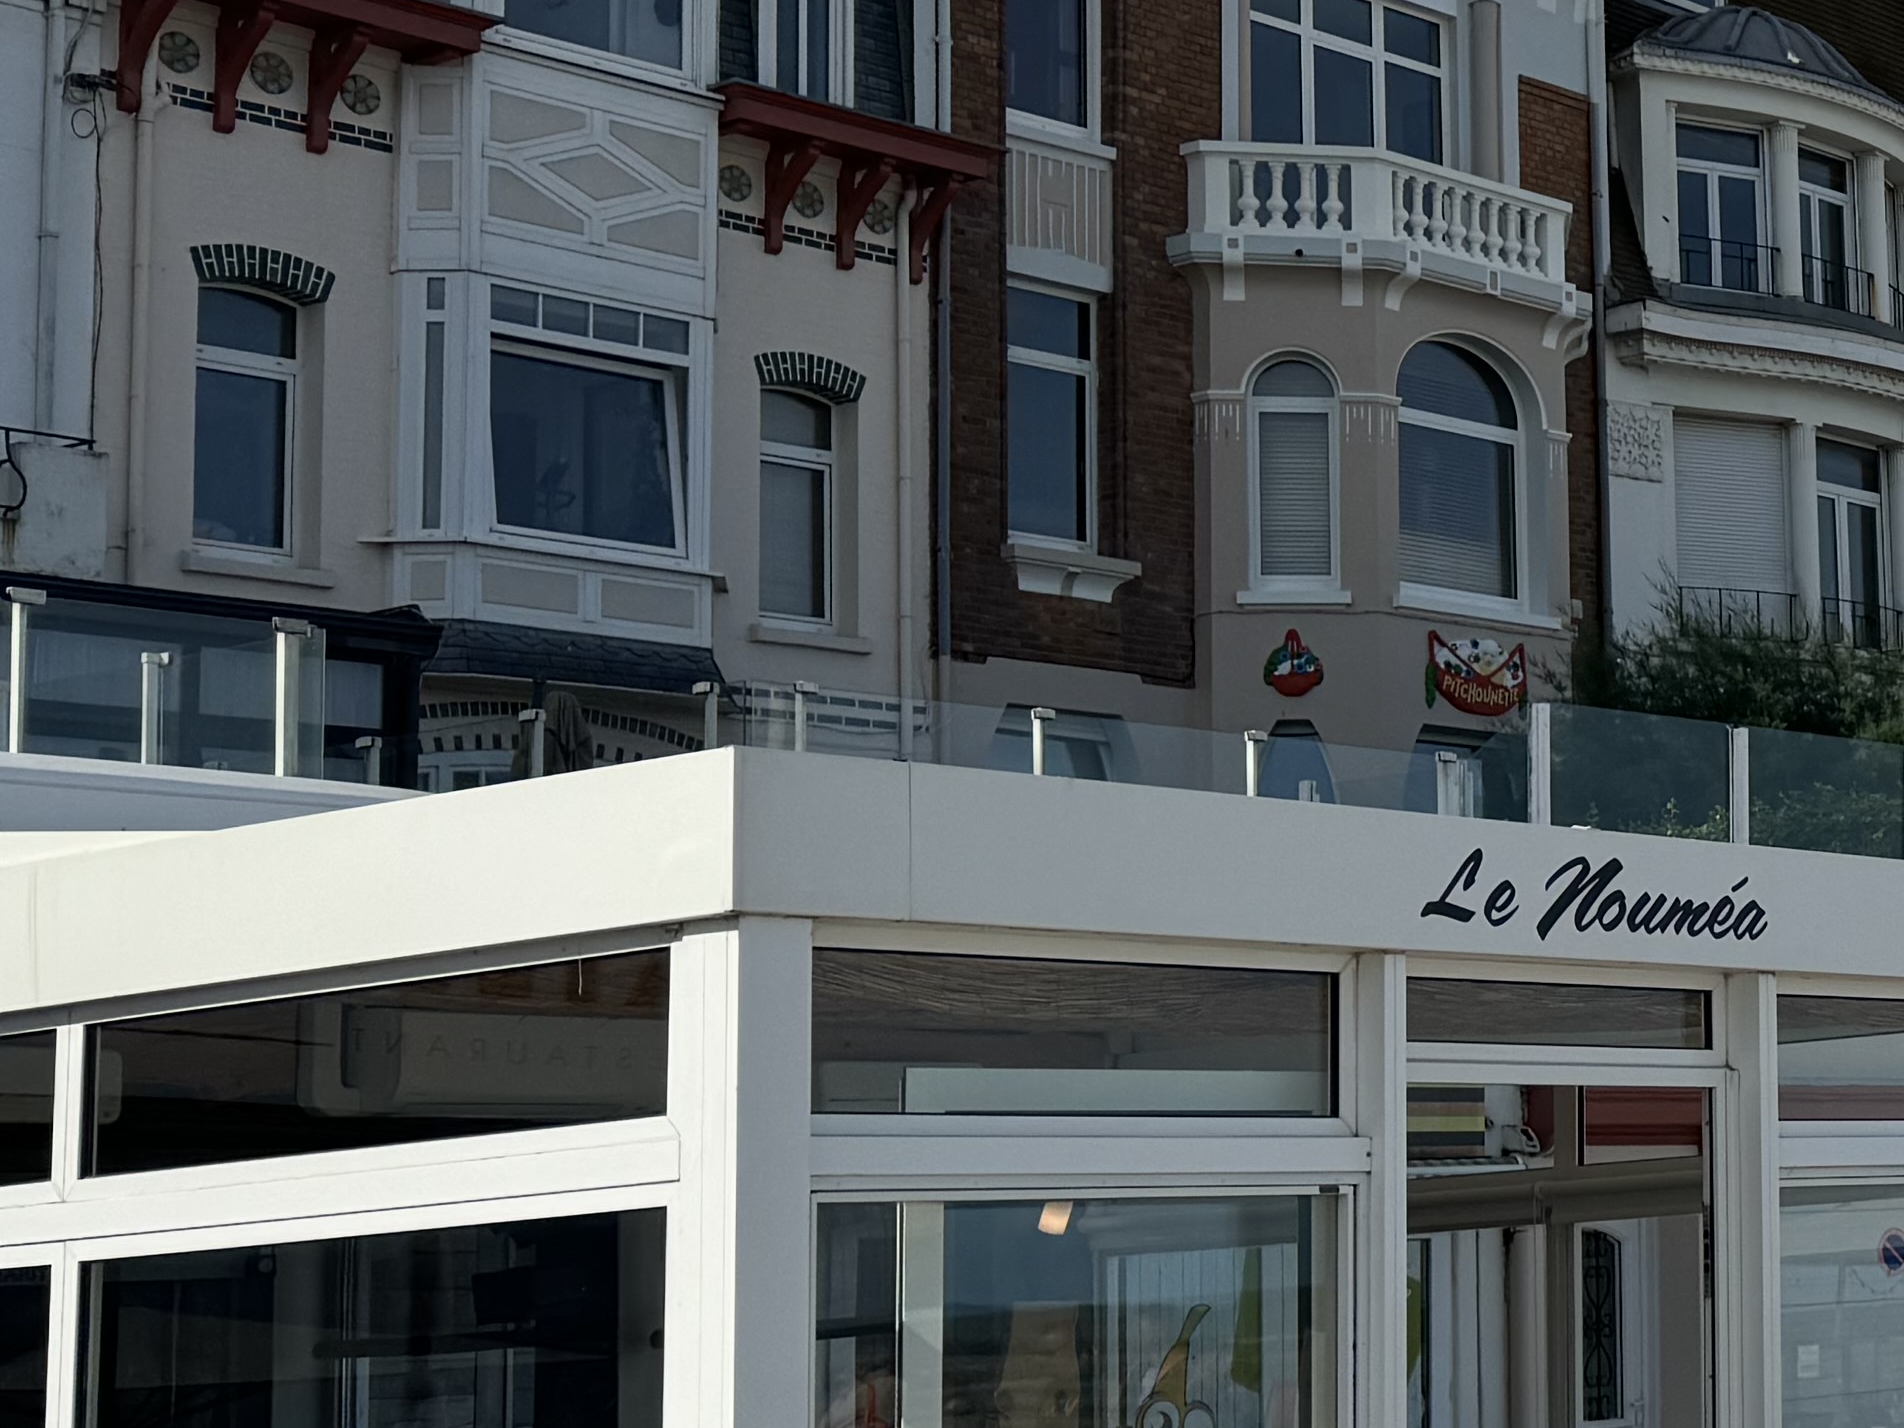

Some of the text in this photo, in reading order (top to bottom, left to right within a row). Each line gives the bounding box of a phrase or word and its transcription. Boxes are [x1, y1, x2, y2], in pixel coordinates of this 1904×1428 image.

[1443, 675, 1519, 707] PITCHOUNETTE
[1420, 847, 1769, 942] Le Nouméa
